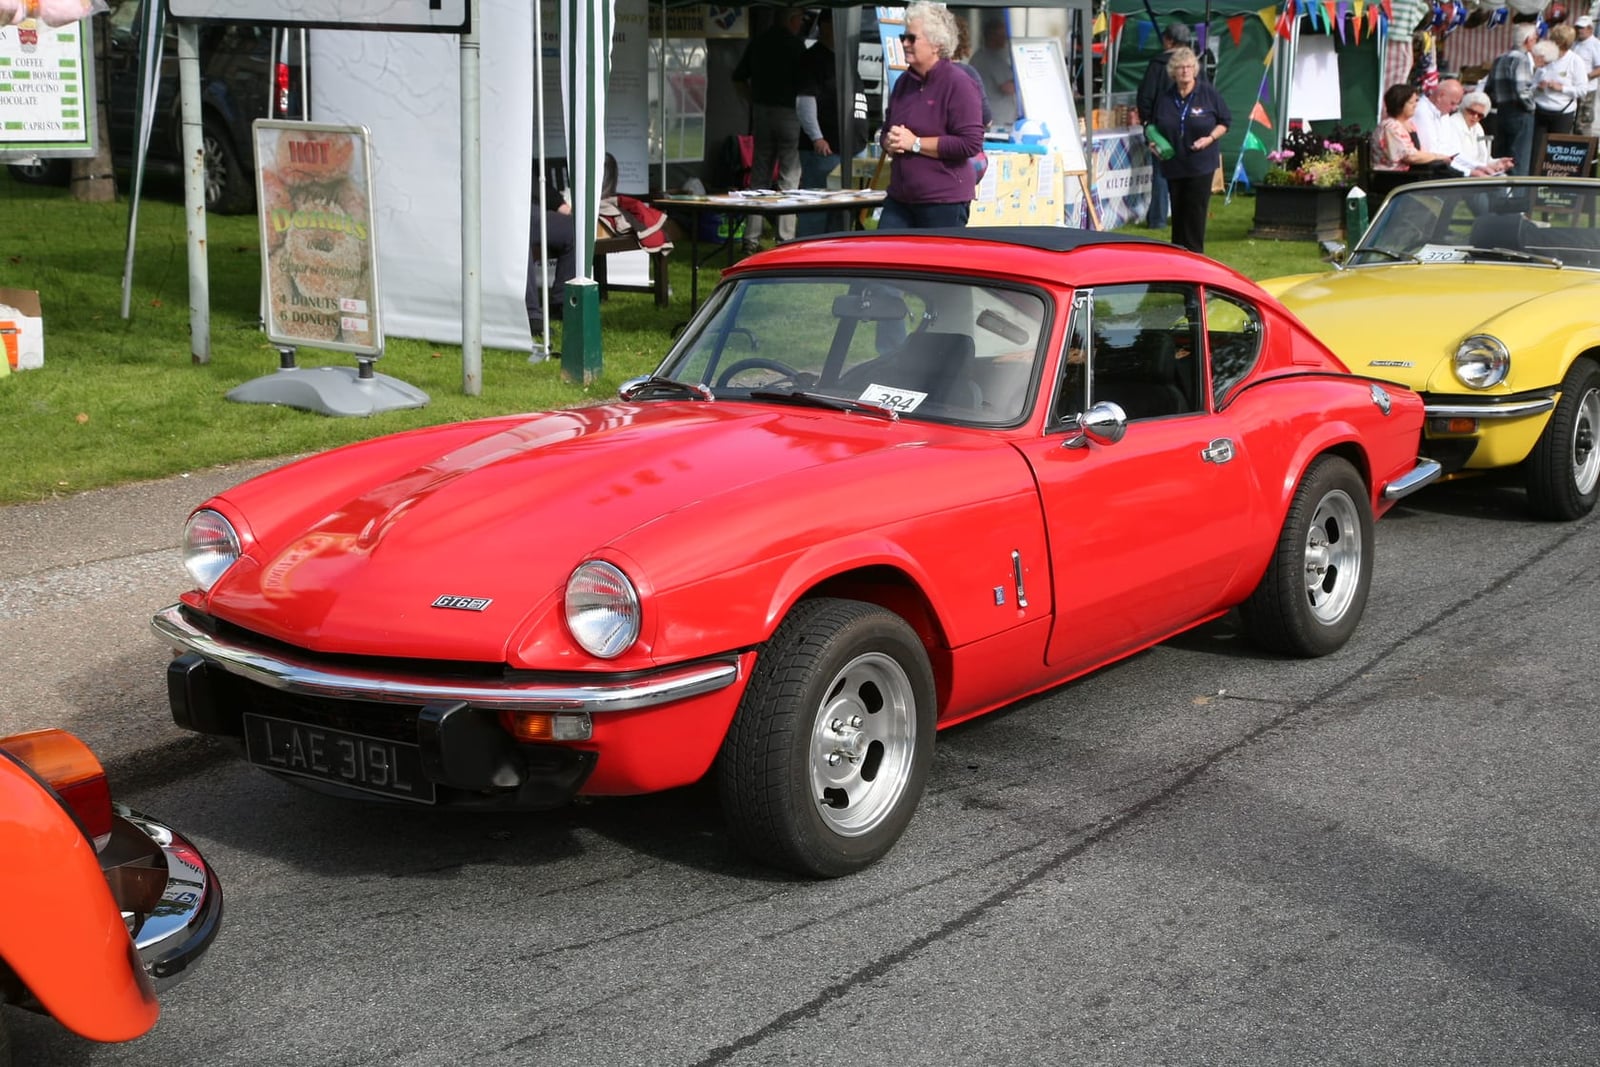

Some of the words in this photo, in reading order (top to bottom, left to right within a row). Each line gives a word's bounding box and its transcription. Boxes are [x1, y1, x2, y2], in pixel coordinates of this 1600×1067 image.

[15, 58, 43, 67] COFFEE
[32, 71, 59, 80] BOVRIL
[12, 84, 59, 93] CAPPUCCINO
[288, 140, 331, 164] HOT
[1106, 176, 1133, 189] KILTED
[272, 207, 368, 241] Donuts
[1426, 251, 1453, 261] 370
[292, 295, 338, 311] DONUTS
[280, 310, 288, 321] 6
[292, 312, 339, 327] DONUTS
[878, 393, 915, 410] 384
[436, 596, 473, 607] GT6
[265, 721, 329, 773] LAE
[337, 739, 412, 792] 319L
